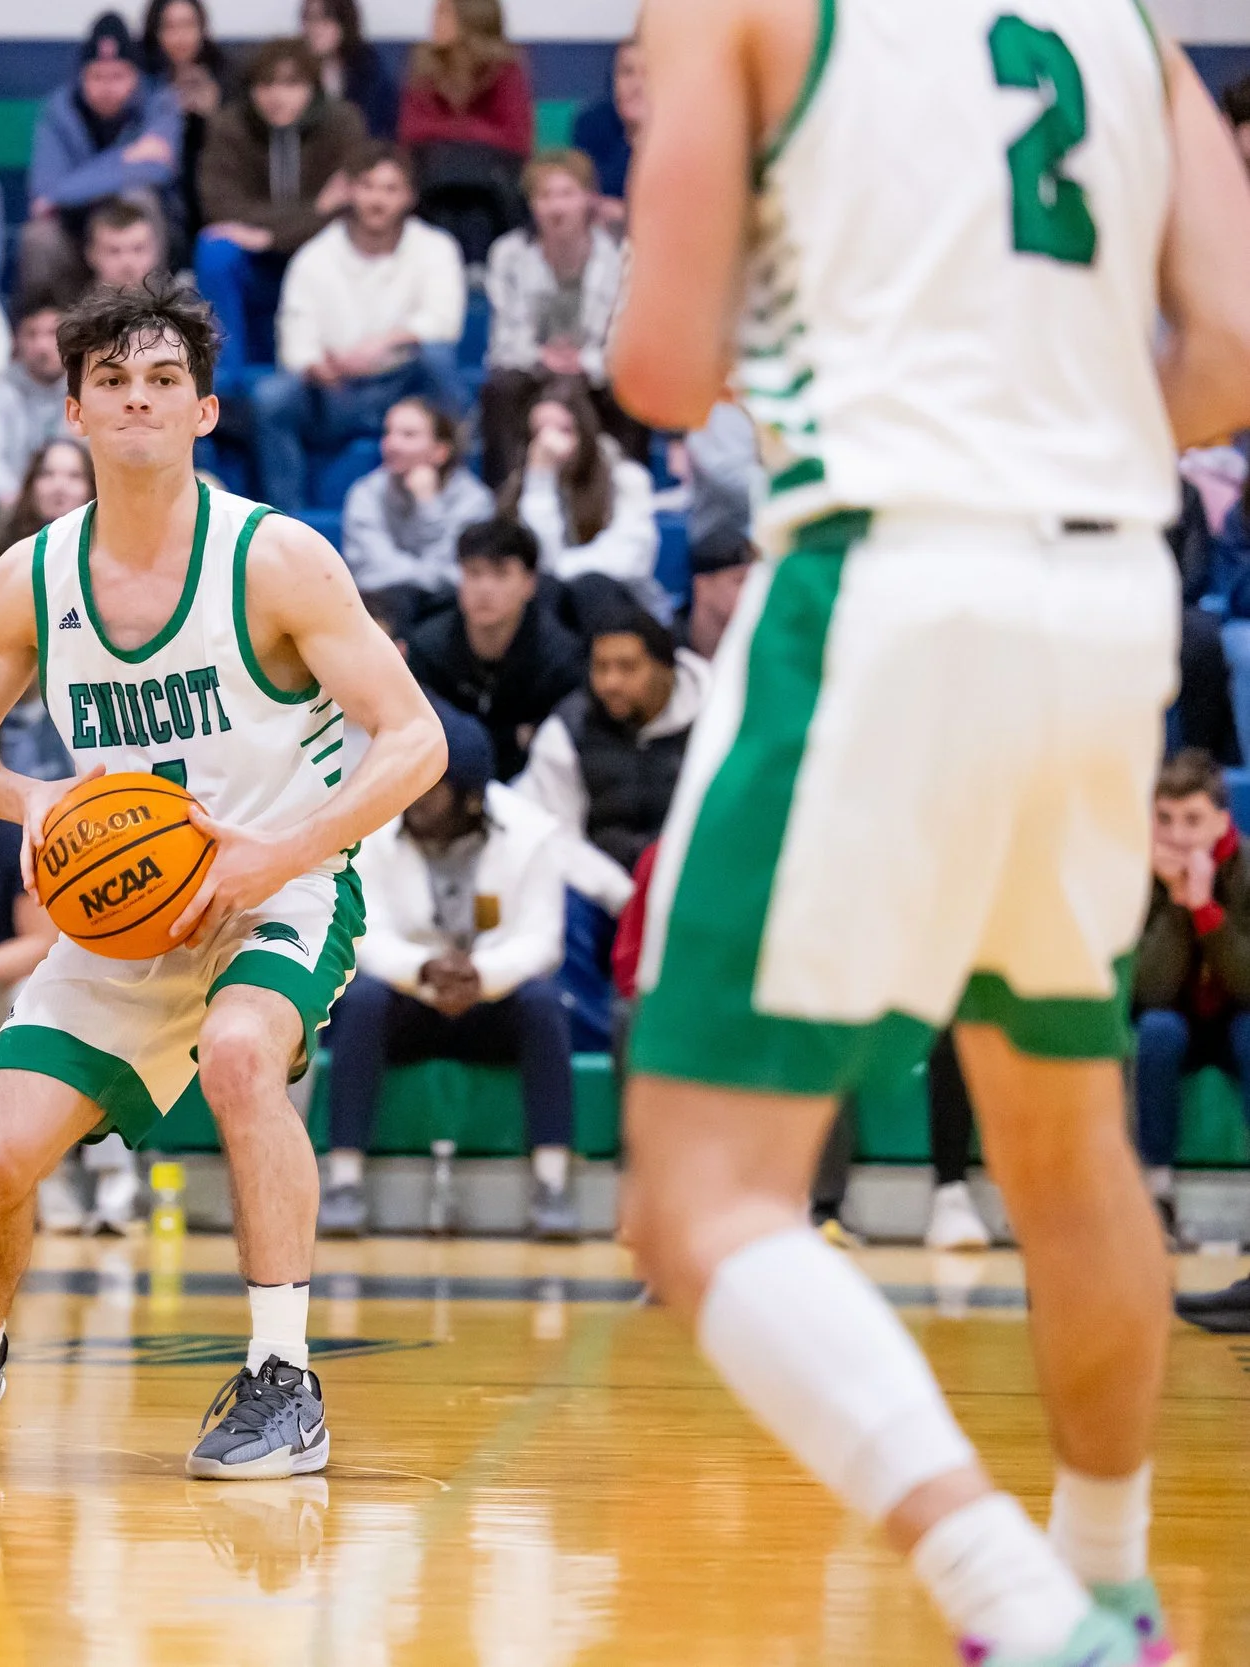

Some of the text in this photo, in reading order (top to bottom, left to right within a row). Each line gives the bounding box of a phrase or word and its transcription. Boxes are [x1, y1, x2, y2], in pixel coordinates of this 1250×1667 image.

[987, 14, 1099, 269] 2
[43, 805, 152, 878] Wilson
[79, 856, 164, 919] NCAA
